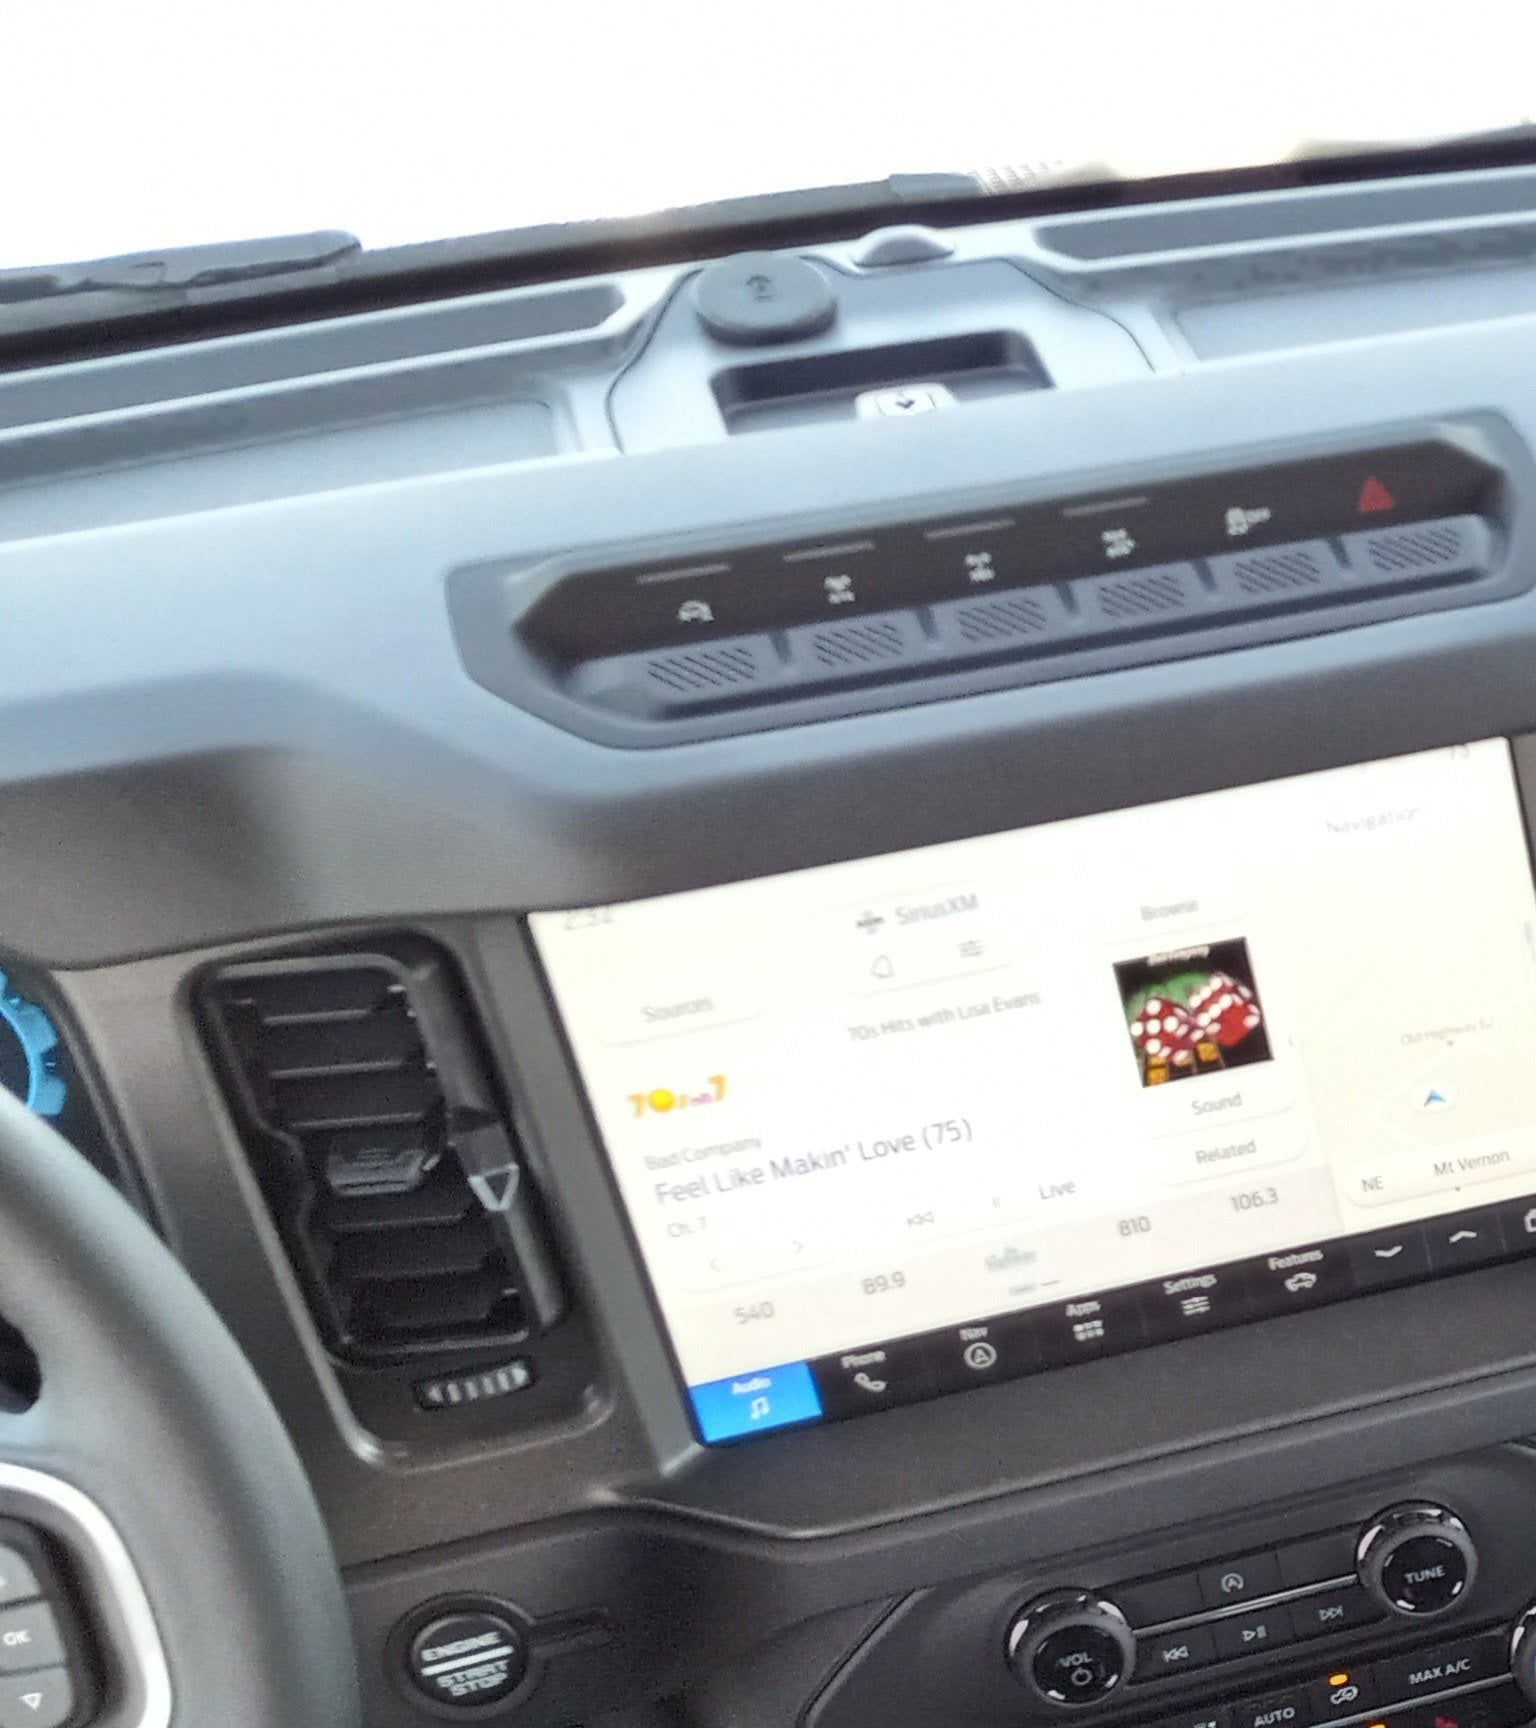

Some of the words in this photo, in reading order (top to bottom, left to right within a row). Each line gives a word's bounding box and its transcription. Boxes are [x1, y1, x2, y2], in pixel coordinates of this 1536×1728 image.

[895, 894, 979, 926] SiriusXM
[1140, 899, 1199, 923] Browse
[640, 997, 716, 1024] Sources
[1191, 1091, 1244, 1116] Sound
[654, 1176, 711, 1205] Feel
[713, 1164, 765, 1193] Like
[769, 1143, 851, 1181] Makin'
[857, 1132, 915, 1162] Love
[921, 1118, 973, 1151] (75)
[1195, 1140, 1257, 1165] Related
[1360, 1175, 1386, 1194] NE
[1433, 1160, 1454, 1178] Mt
[1456, 1148, 1511, 1173] Vernon
[1037, 1179, 1076, 1201] Live
[734, 1301, 775, 1324] 540
[861, 1270, 907, 1295] 89.9
[1117, 1215, 1151, 1238] 810
[1229, 1187, 1280, 1214] 106.3
[1267, 1249, 1324, 1271] Features
[1162, 1273, 1218, 1296] Settings
[1065, 1300, 1102, 1319] Apps
[957, 1326, 989, 1342] Nav
[840, 1349, 887, 1370] Phone
[731, 1376, 772, 1396] Audio
[1404, 1565, 1446, 1584] TUNE
[2, 1630, 32, 1646] OK
[421, 1631, 501, 1661] ENGINE
[1058, 1651, 1093, 1668] VOL
[1409, 1667, 1443, 1685] MAX
[1443, 1658, 1472, 1676] A/C
[437, 1660, 509, 1687] START
[450, 1672, 508, 1696] STOP
[1253, 1706, 1296, 1728] AUTO
